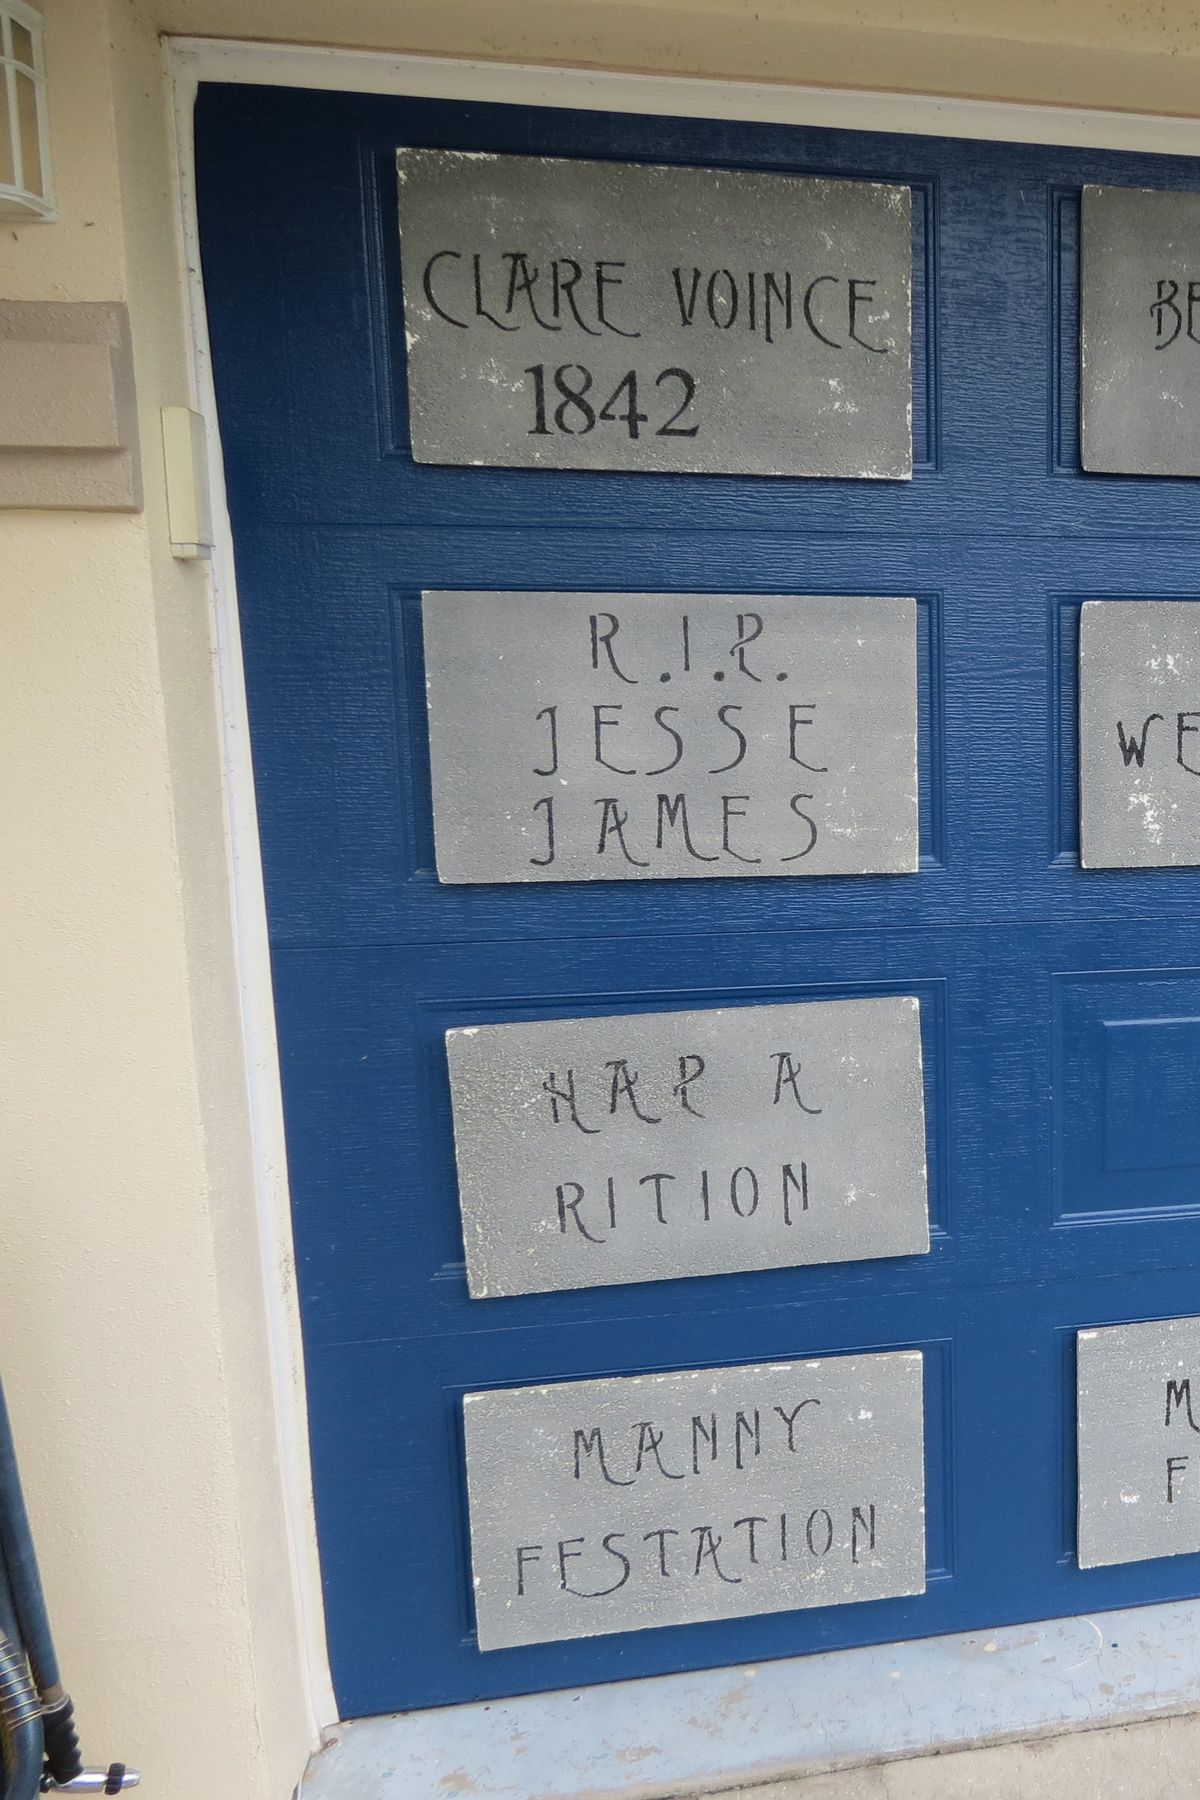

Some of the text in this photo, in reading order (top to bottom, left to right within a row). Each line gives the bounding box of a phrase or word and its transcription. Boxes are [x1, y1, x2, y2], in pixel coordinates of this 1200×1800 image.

[423, 250, 889, 354] CLARE VOINCE
[524, 363, 700, 439] 1842
[532, 704, 829, 777] JESSE
[529, 793, 819, 868] JAMES
[556, 1161, 810, 1244] RITION
[573, 1398, 821, 1486] MANNY
[516, 1504, 876, 1598] FESTATION
